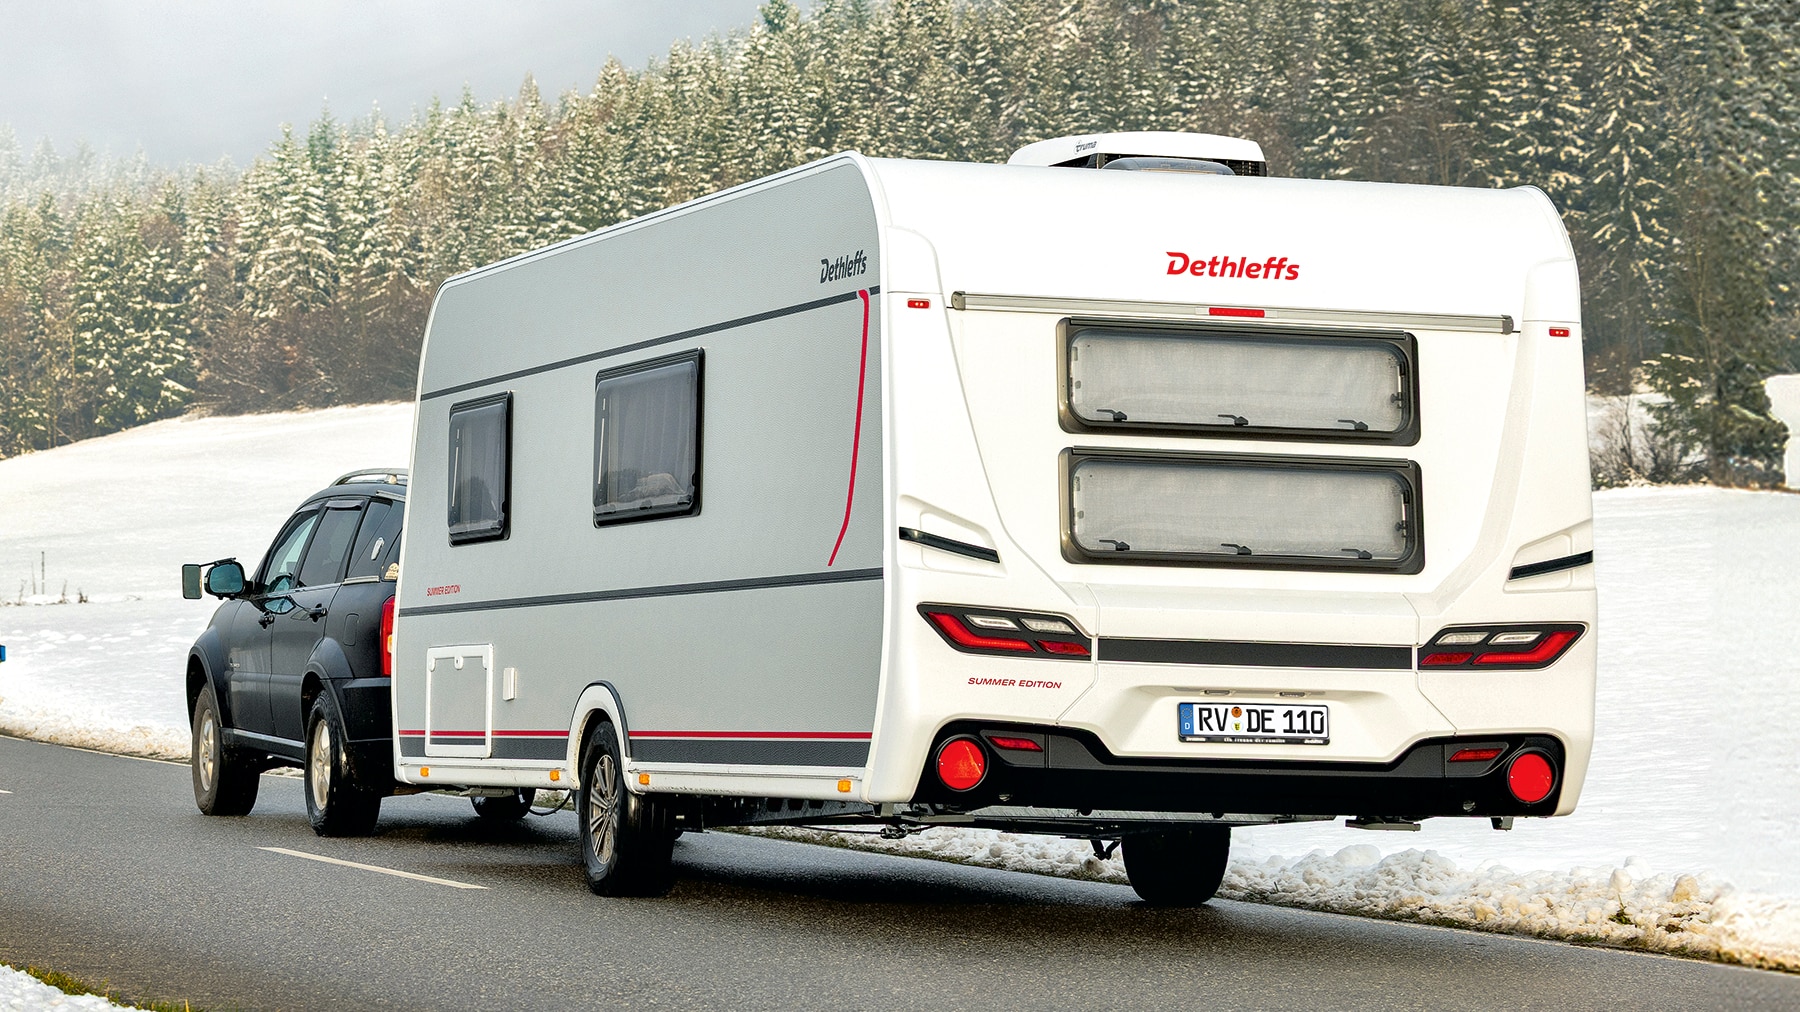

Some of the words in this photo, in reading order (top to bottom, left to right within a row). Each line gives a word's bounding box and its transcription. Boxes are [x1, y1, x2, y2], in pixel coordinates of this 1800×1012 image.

[820, 250, 867, 284] Dethleffs
[1166, 251, 1300, 281] Dethleffs
[968, 677, 1016, 687] SUMMER
[1018, 679, 1062, 689] EDITION
[1184, 722, 1191, 730] D
[1198, 707, 1229, 732] RV
[1246, 708, 1276, 734] DE
[1283, 710, 1325, 735] 110
